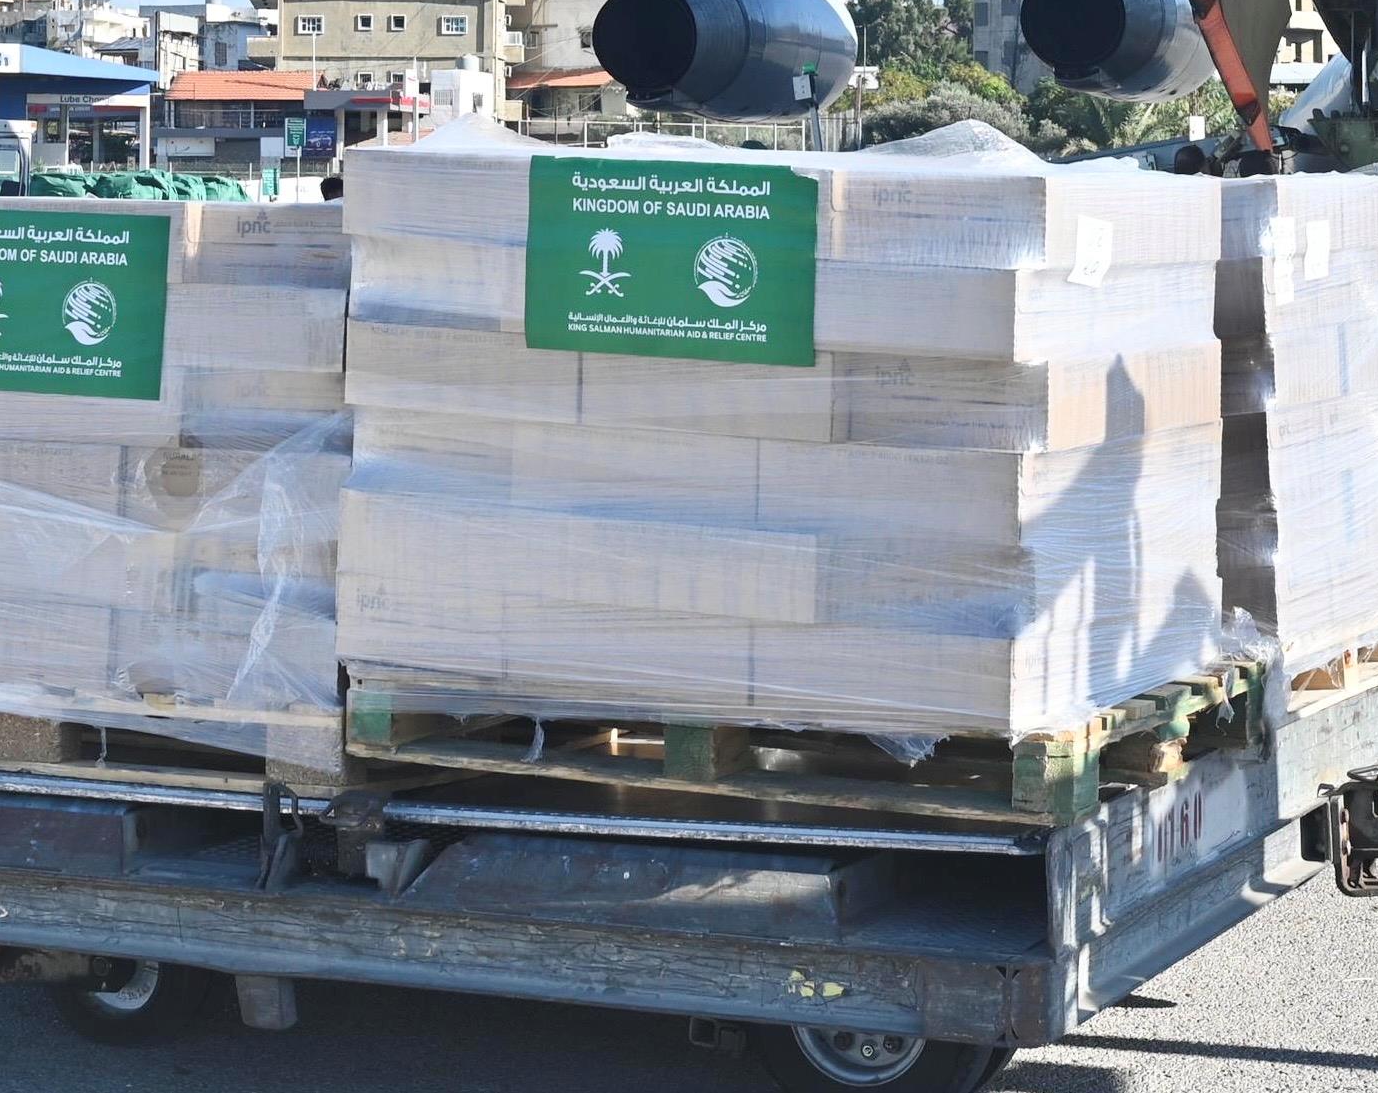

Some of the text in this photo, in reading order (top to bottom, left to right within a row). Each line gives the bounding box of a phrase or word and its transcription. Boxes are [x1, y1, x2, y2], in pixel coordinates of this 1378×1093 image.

[60, 94, 80, 104] Lube
[572, 171, 771, 196] المملكة العربية السعودية
[572, 197, 770, 220] KINGDOM OF SAUDI ARABIA
[26, 225, 73, 244] العربية
[74, 226, 130, 245] المملكة
[20, 248, 37, 262] OF
[39, 249, 78, 264] SAUDI
[79, 251, 128, 266] ARABIA
[666, 315, 707, 330] سلمان
[707, 317, 739, 331] الملك
[568, 323, 767, 343] KING SALMAN HUMANITARIAN AID & RELIEF CENTRE
[52, 366, 66, 375] AID
[65, 366, 72, 375] &
[71, 367, 95, 377] RELIEF
[95, 368, 122, 378] CENTRE
